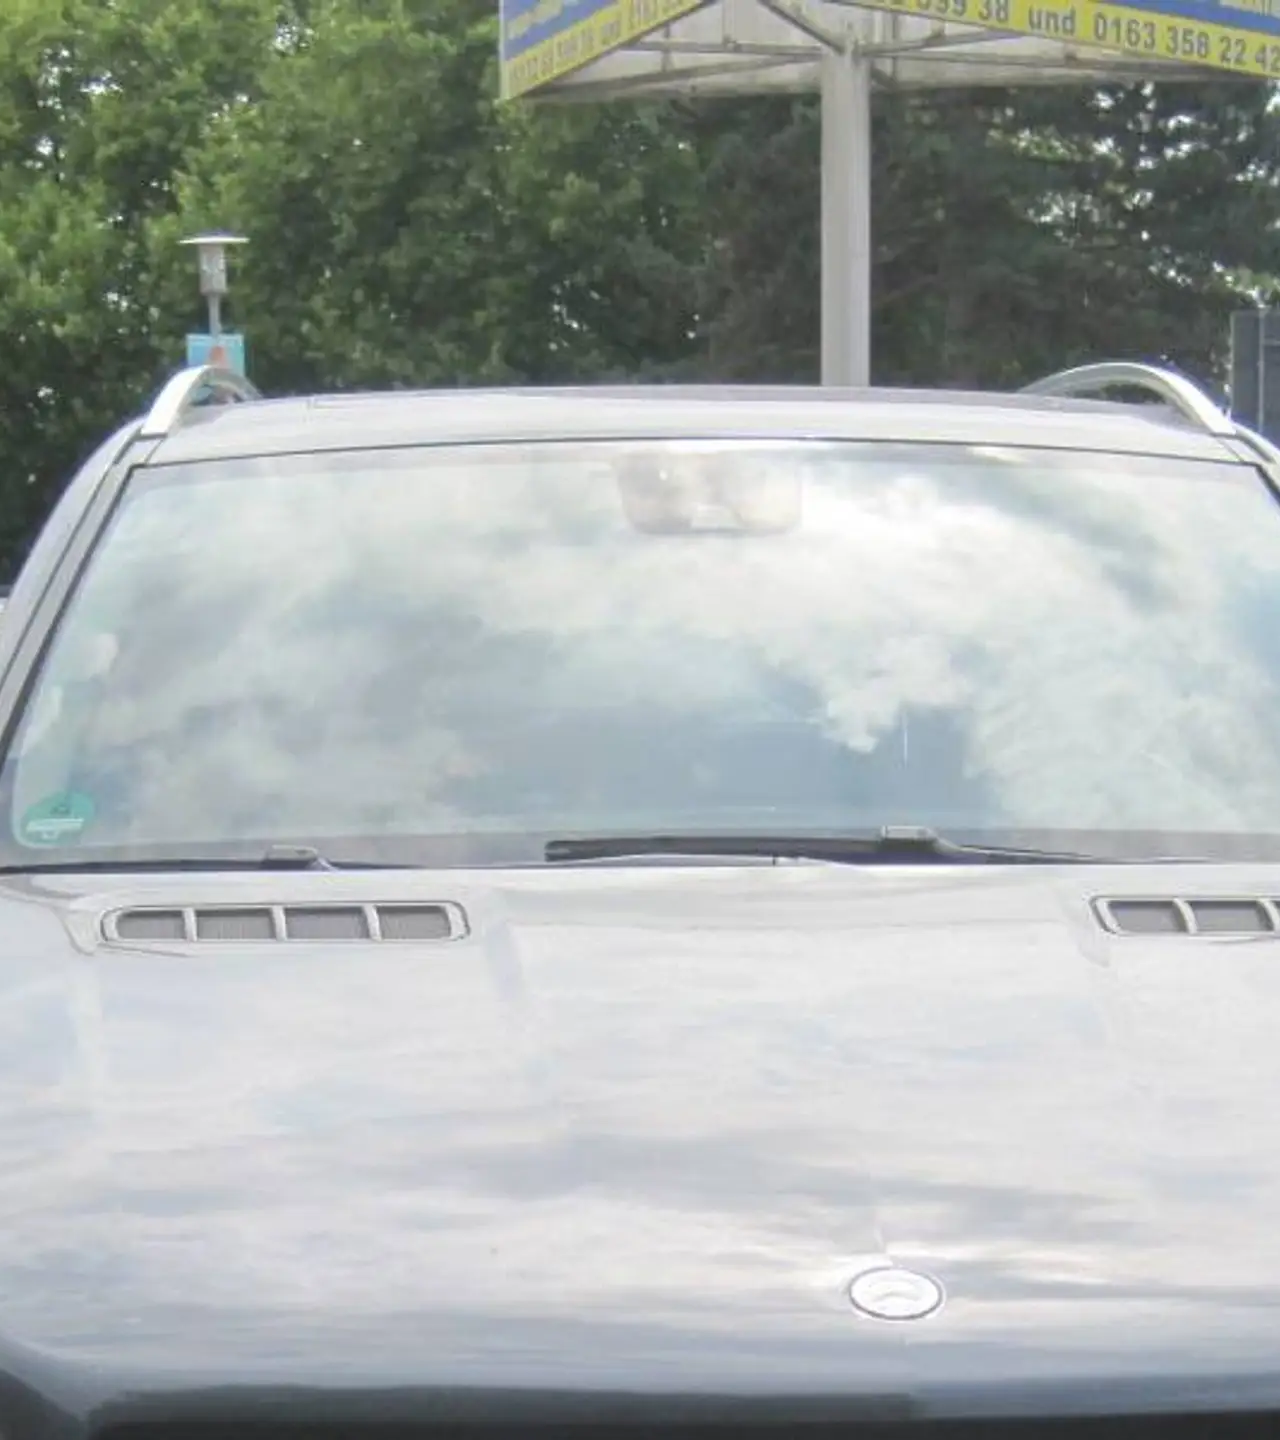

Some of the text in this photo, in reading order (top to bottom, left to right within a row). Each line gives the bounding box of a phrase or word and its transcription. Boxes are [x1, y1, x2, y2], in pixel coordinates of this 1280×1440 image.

[1028, 5, 1076, 34] und
[1094, 12, 1156, 49] 0163
[1166, 26, 1210, 59] 358
[1220, 36, 1247, 66] 22
